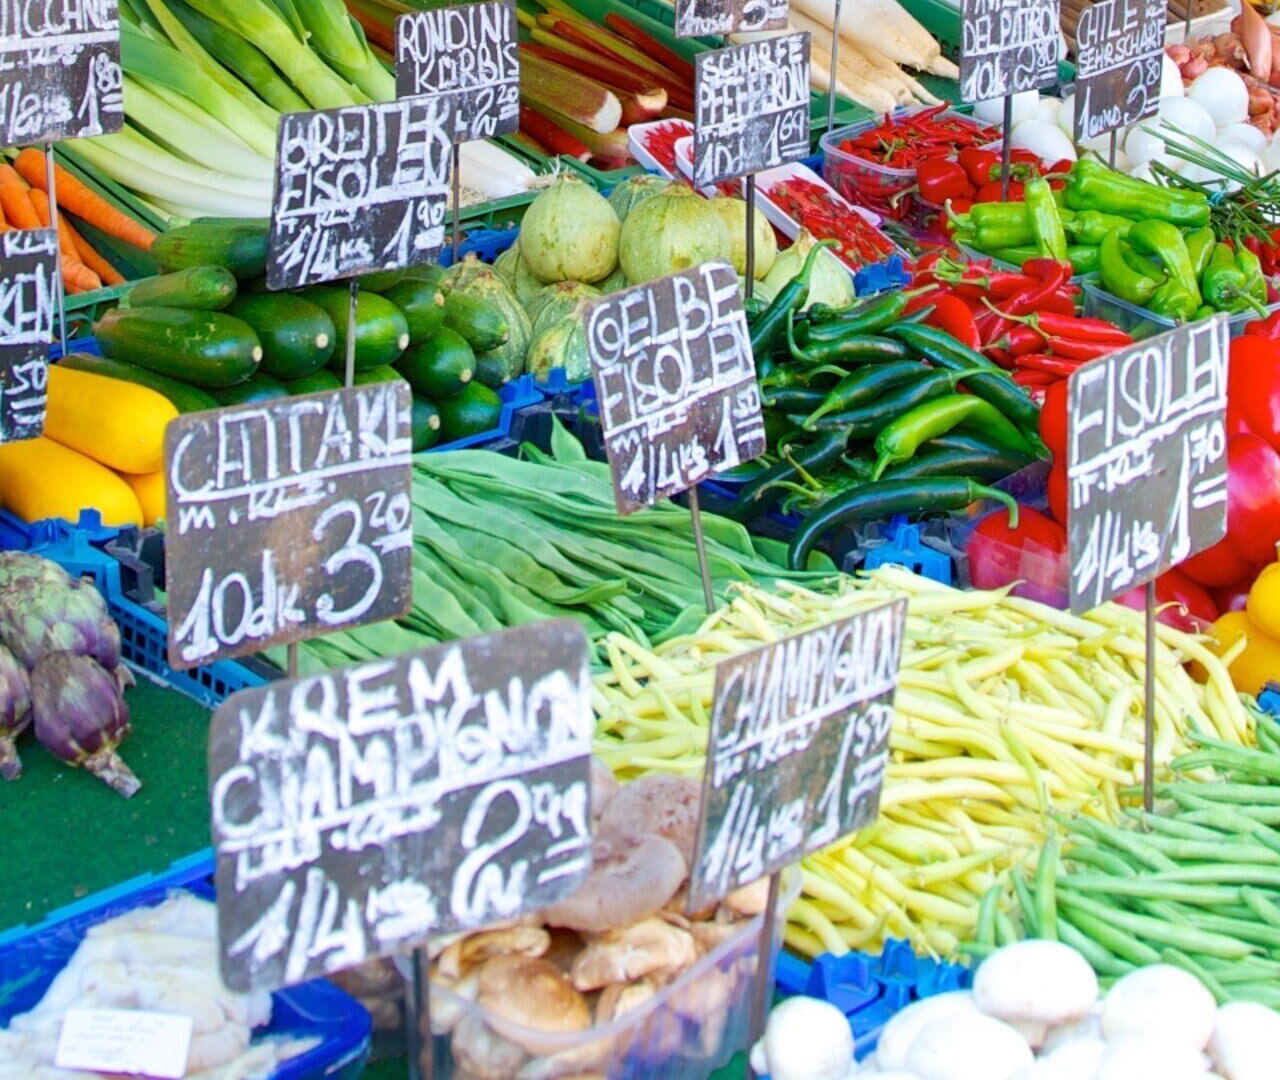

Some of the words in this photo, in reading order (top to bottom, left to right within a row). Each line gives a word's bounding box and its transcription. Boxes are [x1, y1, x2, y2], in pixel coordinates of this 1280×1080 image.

[398, 2, 511, 64] RONDINI
[588, 261, 747, 370] GELBE
[598, 309, 758, 431] FISOLEN
[1070, 316, 1230, 467] FISOLEN
